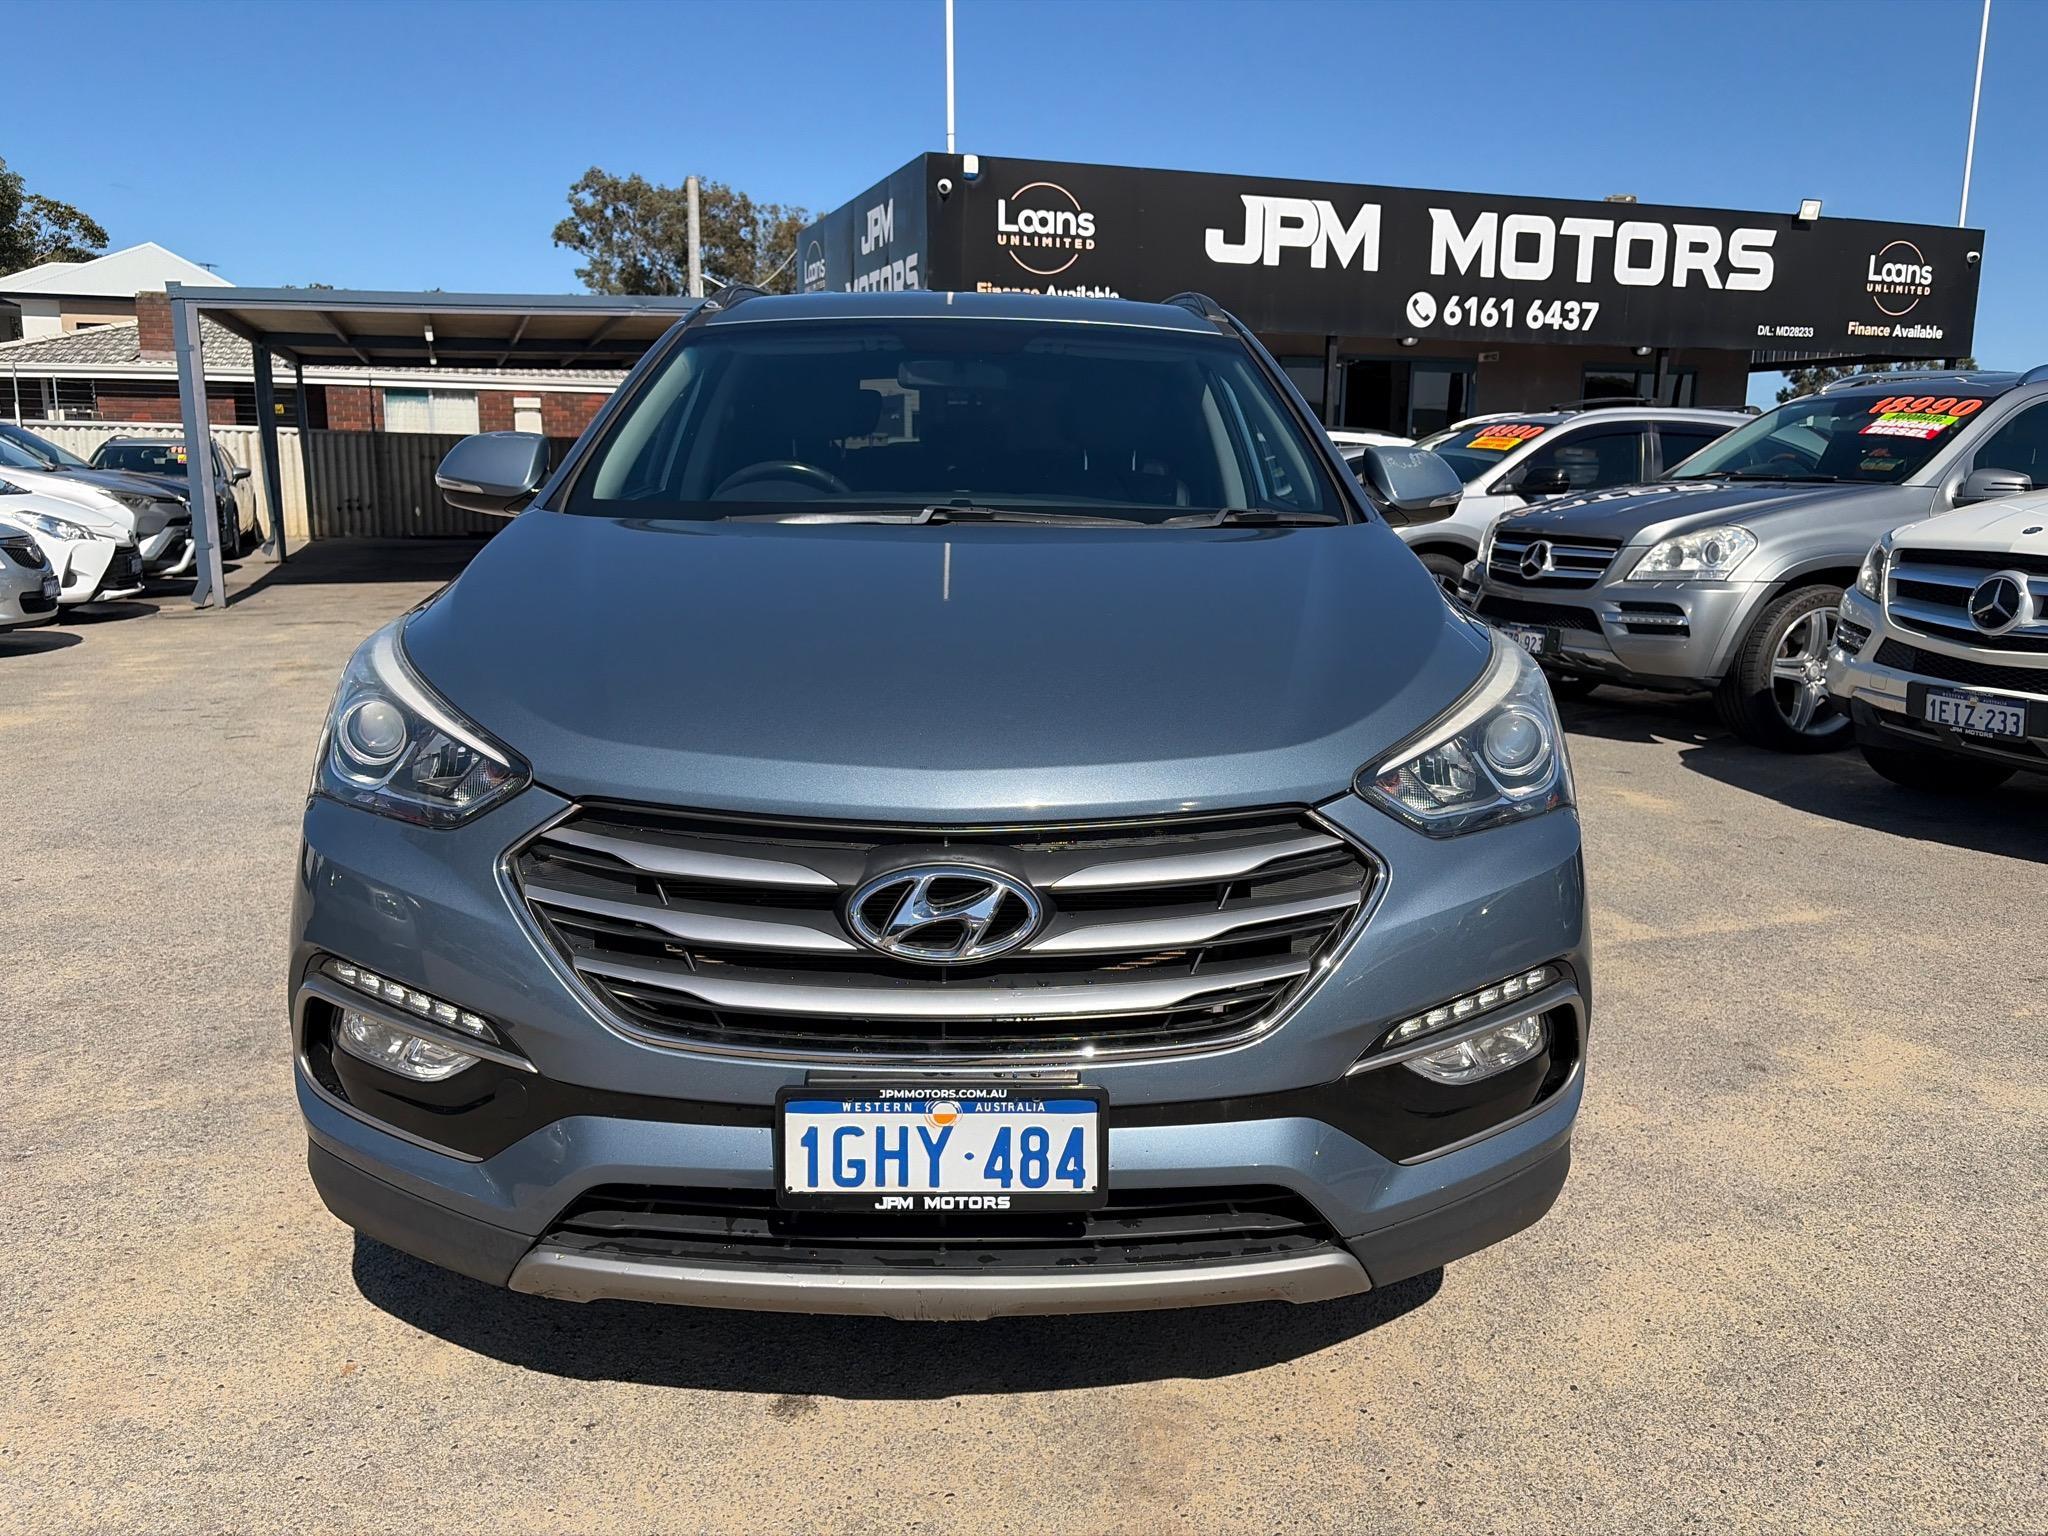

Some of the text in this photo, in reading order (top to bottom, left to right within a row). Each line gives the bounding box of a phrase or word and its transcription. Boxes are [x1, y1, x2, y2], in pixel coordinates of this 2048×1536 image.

[860, 198, 894, 256] JPM
[998, 199, 1096, 237] Loans
[997, 234, 1096, 250] UNLIMITED
[1204, 194, 1777, 292] JPM MOTORS
[845, 252, 919, 293] TORS
[1868, 255, 1932, 285] Loans
[1867, 283, 1931, 295] UNLIMITED
[1442, 295, 1600, 332] 6161 6437
[1757, 325, 1815, 338] D/L: MD28233
[1847, 321, 1943, 339] Finance Available
[1869, 397, 1983, 416] 18990
[1864, 425, 1930, 438] DIESEL
[879, 1089, 1008, 1099] JPMMOTORS.COM.AU
[842, 1102, 1046, 1113] WESTERN AUSTRALIA
[874, 1196, 1011, 1210] JPM MOTORS
